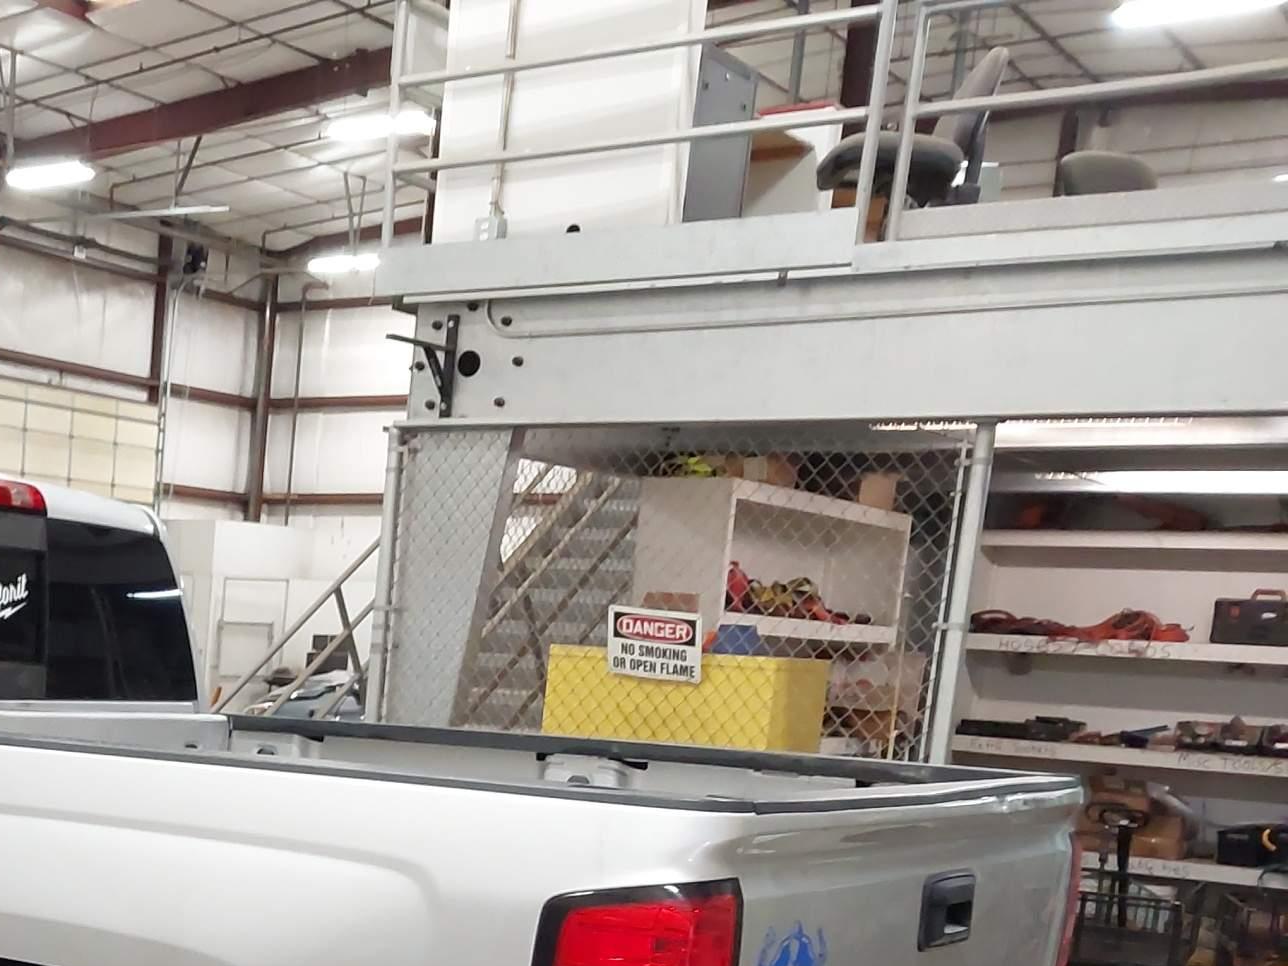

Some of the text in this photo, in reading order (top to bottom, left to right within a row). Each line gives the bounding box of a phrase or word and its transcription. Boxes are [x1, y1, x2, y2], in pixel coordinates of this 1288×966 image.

[622, 619, 687, 640] DANGER
[621, 643, 687, 661] NO SMOKING
[613, 656, 695, 678] OR OPEN FLAME
